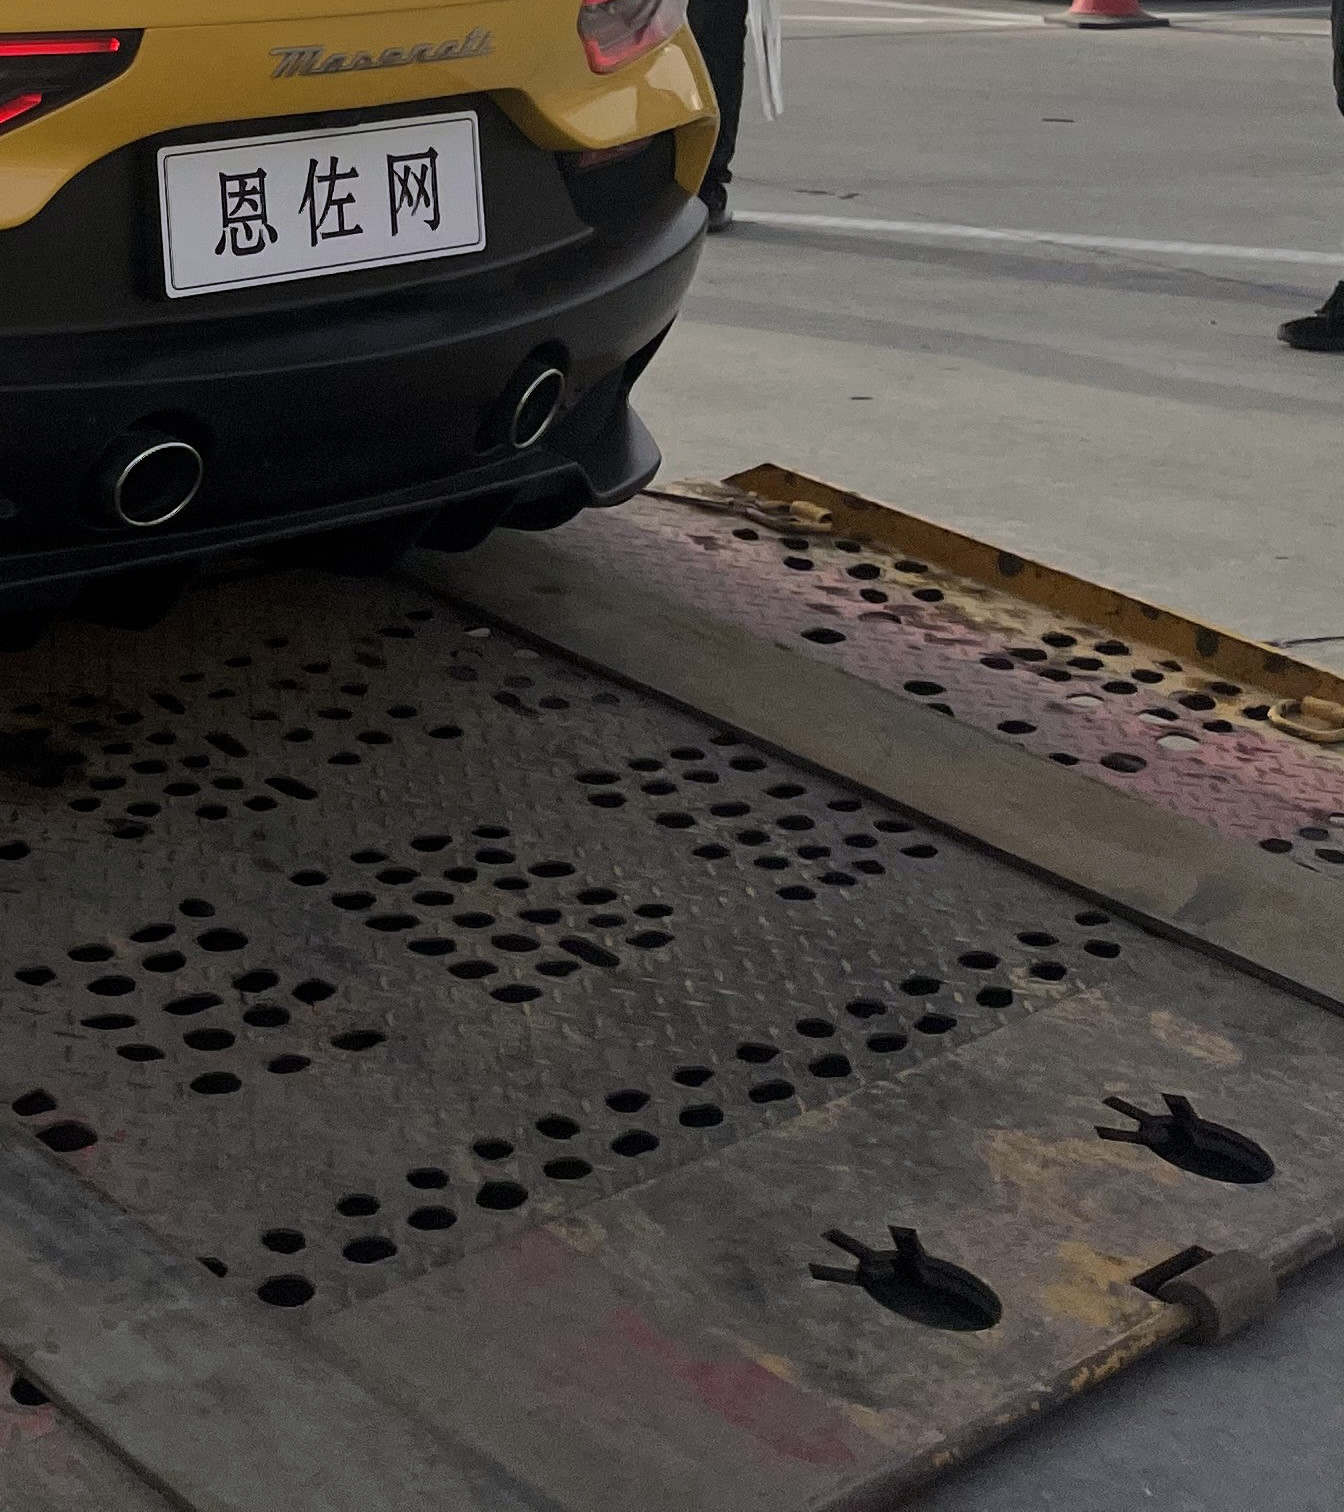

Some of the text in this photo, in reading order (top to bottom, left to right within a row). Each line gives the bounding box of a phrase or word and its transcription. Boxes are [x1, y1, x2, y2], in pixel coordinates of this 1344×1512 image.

[269, 27, 496, 79] Maserati
[215, 146, 441, 257] 恩佐网
